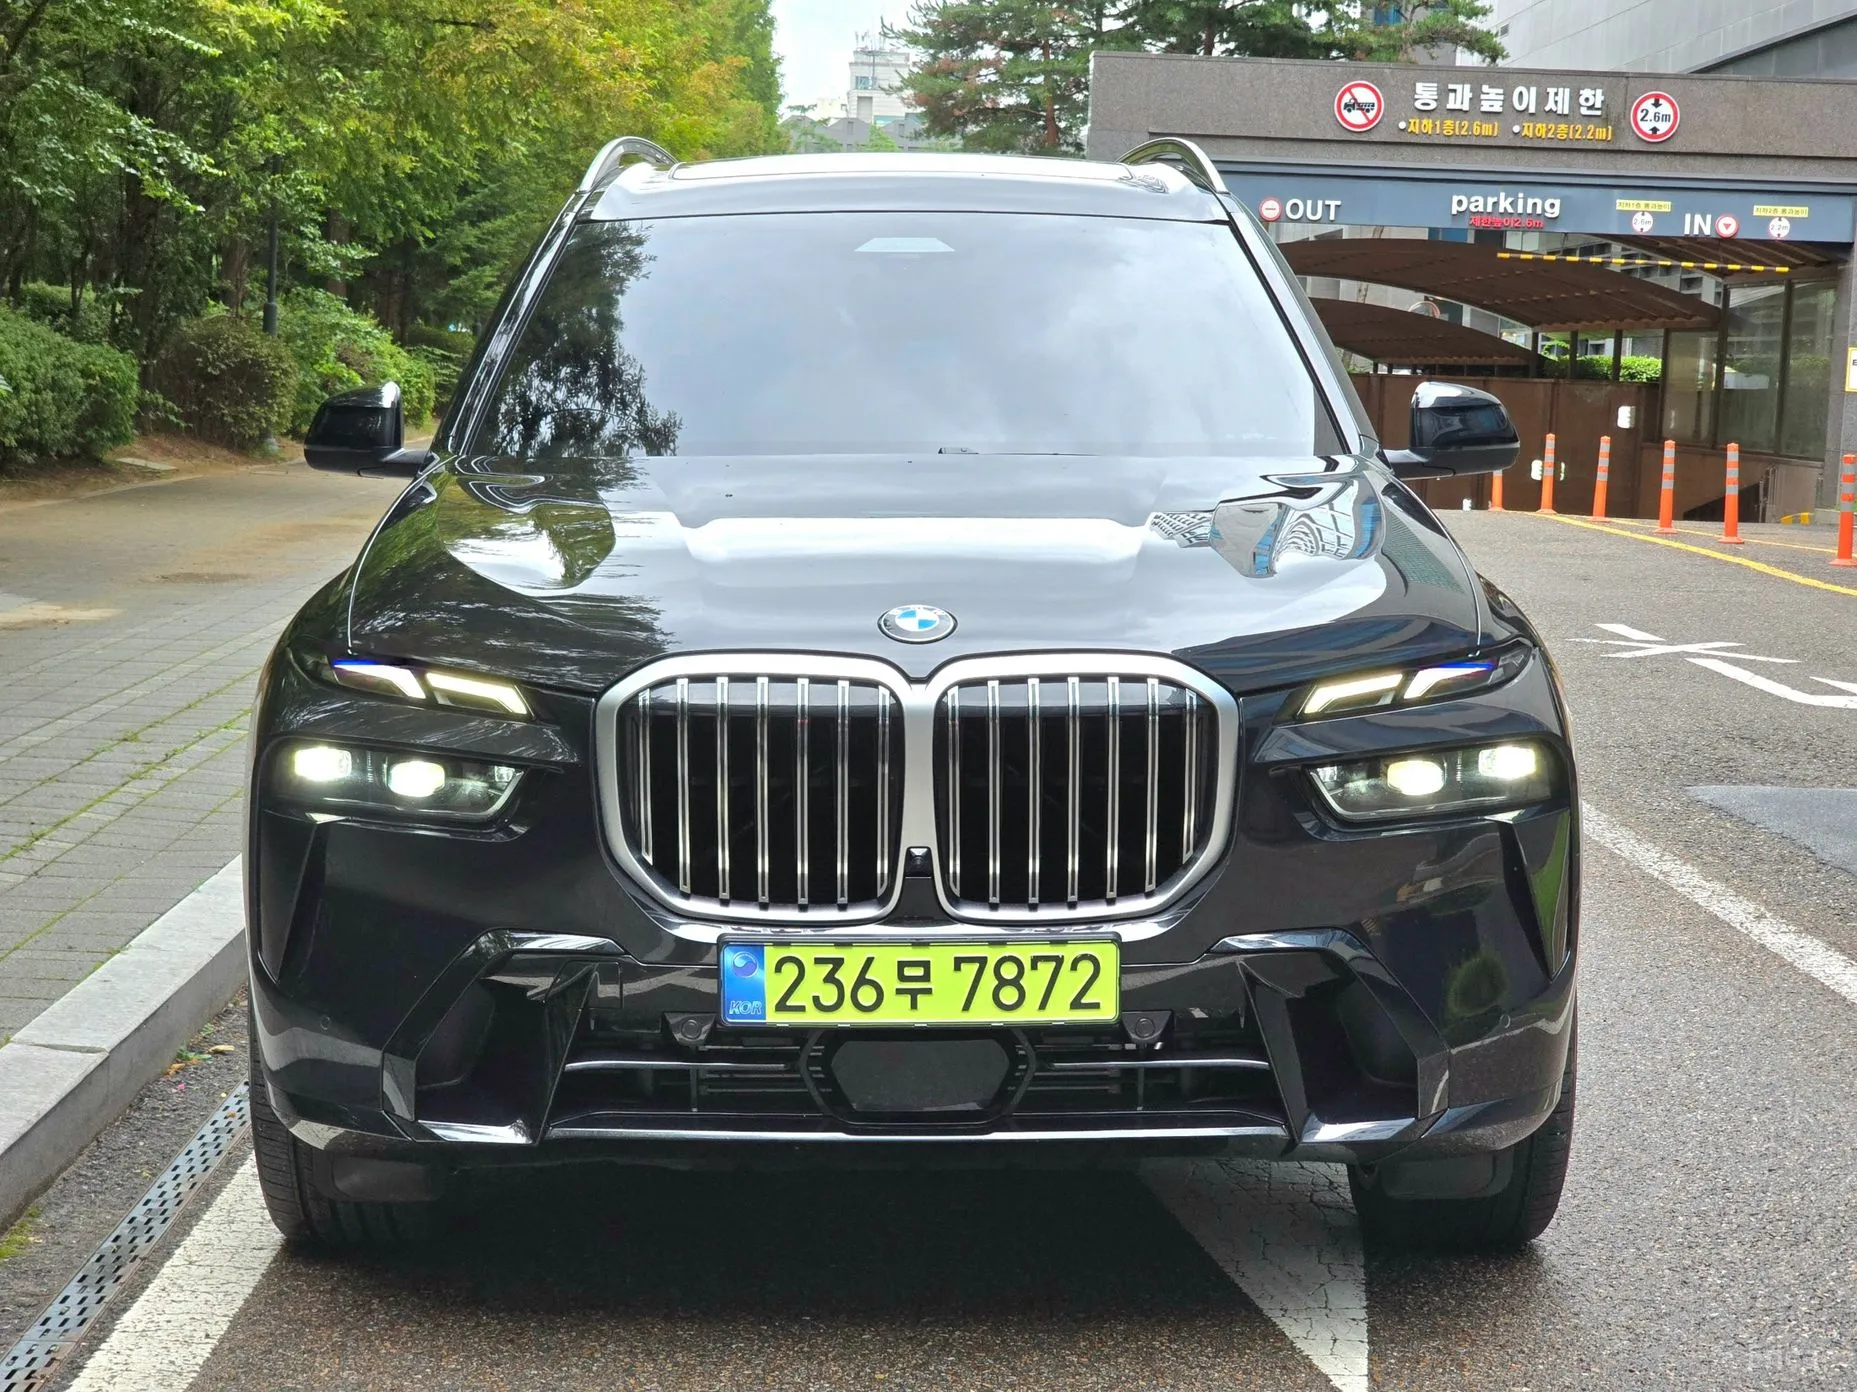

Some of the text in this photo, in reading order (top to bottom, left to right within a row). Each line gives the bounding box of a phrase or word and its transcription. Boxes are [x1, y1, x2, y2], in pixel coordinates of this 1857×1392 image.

[1414, 82, 1605, 116] 통과높이제한
[1640, 108, 1672, 123] 2.6m
[1285, 198, 1342, 221] OUT
[1451, 192, 1561, 218] parking
[1684, 213, 1712, 236] IN
[774, 953, 1102, 1014] 236무 7872
[728, 1000, 763, 1015] KOR
